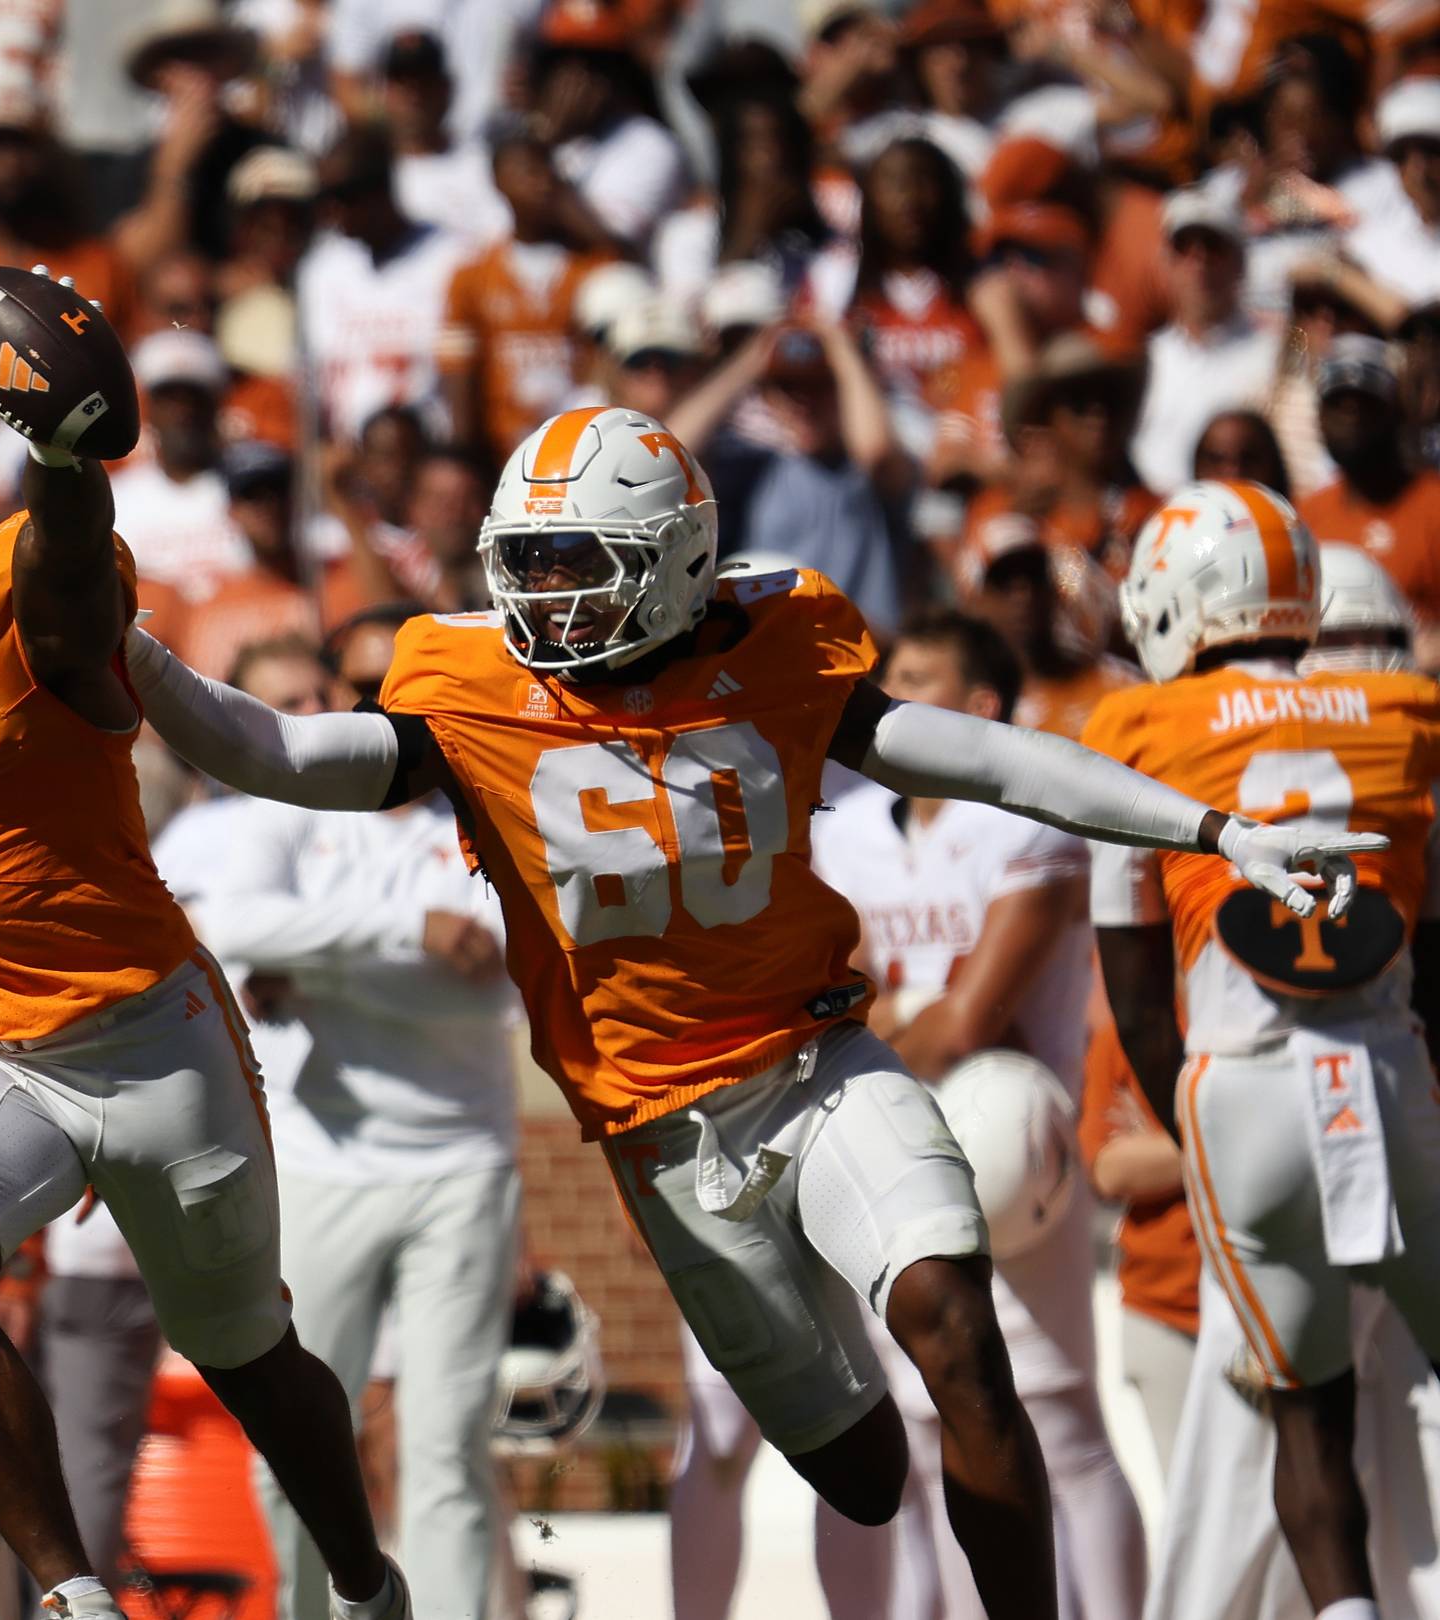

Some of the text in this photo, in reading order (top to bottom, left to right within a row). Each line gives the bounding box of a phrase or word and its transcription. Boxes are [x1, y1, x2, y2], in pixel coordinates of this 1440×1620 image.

[638, 431, 706, 505] T
[1150, 507, 1200, 573] T
[519, 711, 555, 719] HORIZON
[526, 703, 549, 711] FIRST
[1211, 686, 1370, 733] JACKSON
[529, 720, 790, 948] 60
[1270, 898, 1348, 970] T
[1313, 1054, 1351, 1092] T
